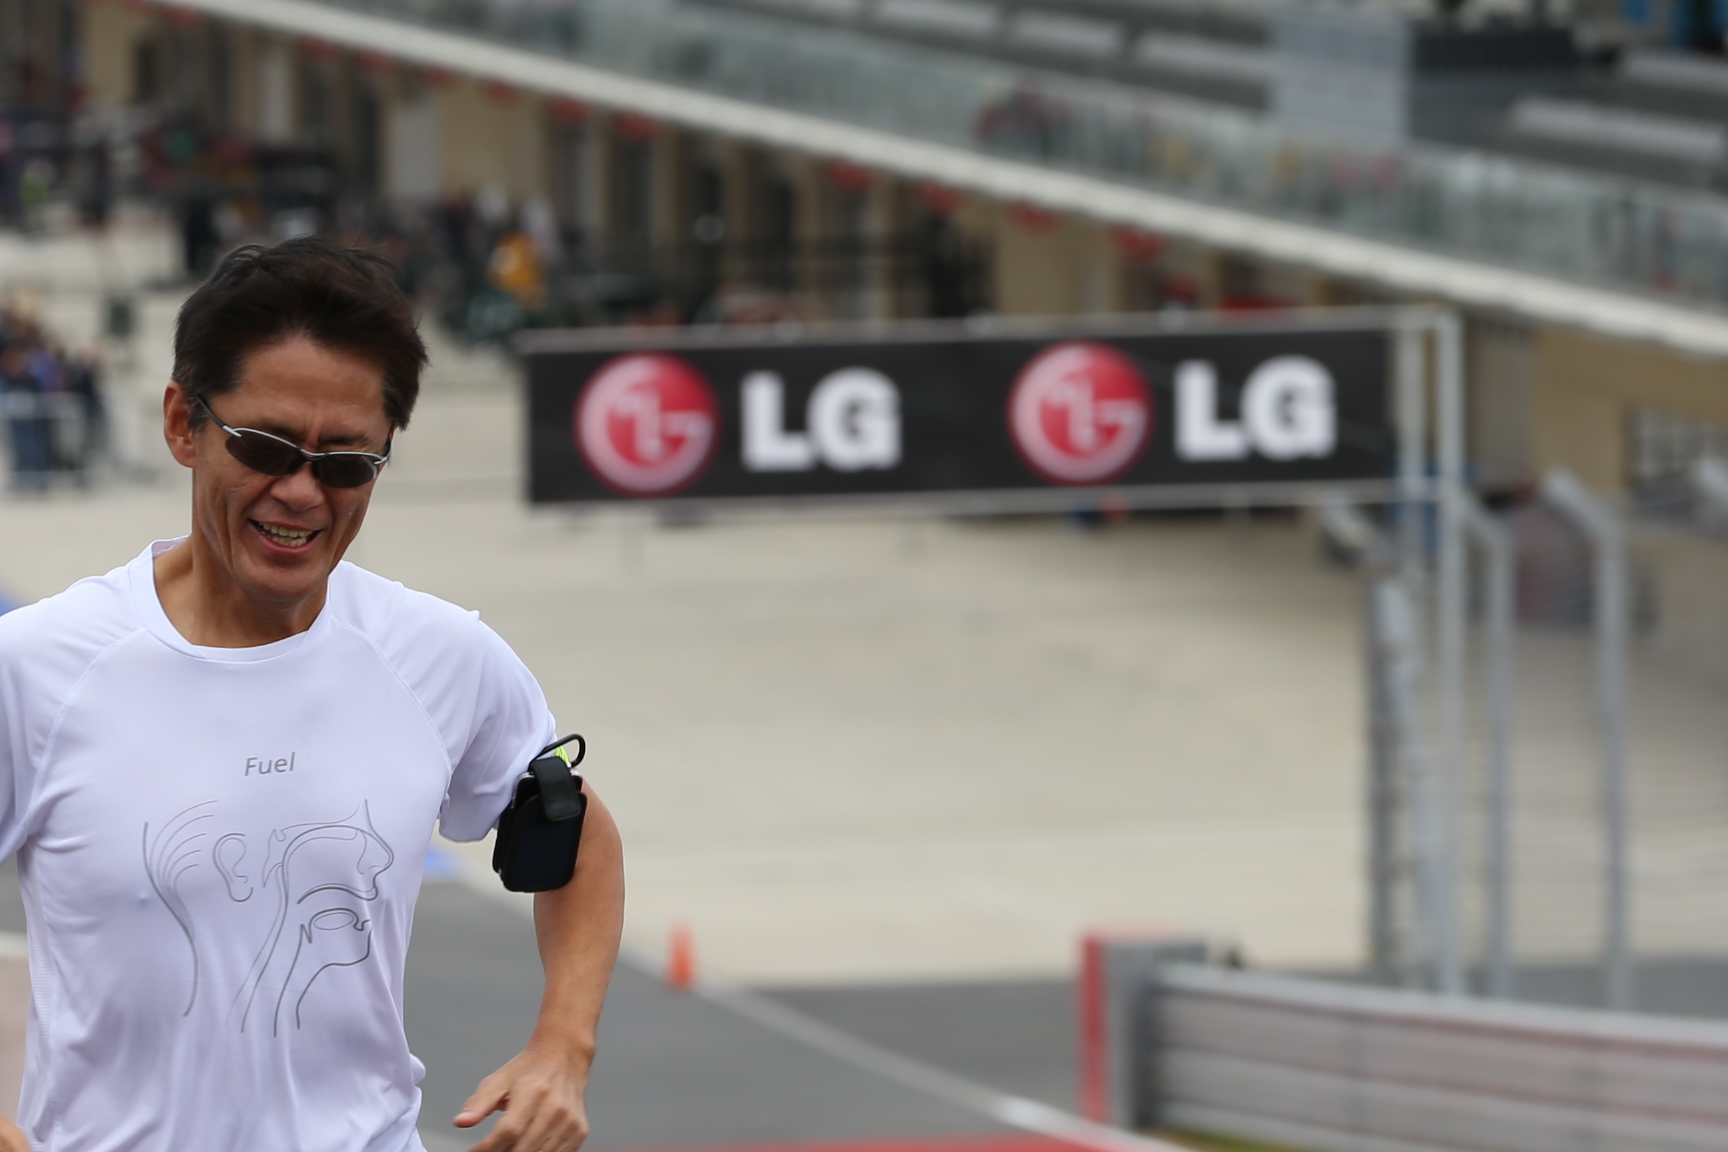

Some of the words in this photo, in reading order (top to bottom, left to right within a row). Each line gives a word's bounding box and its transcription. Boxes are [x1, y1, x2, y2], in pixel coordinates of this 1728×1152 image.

[740, 366, 902, 473] LG
[1174, 355, 1338, 462] LG
[244, 751, 296, 777] Fuel
